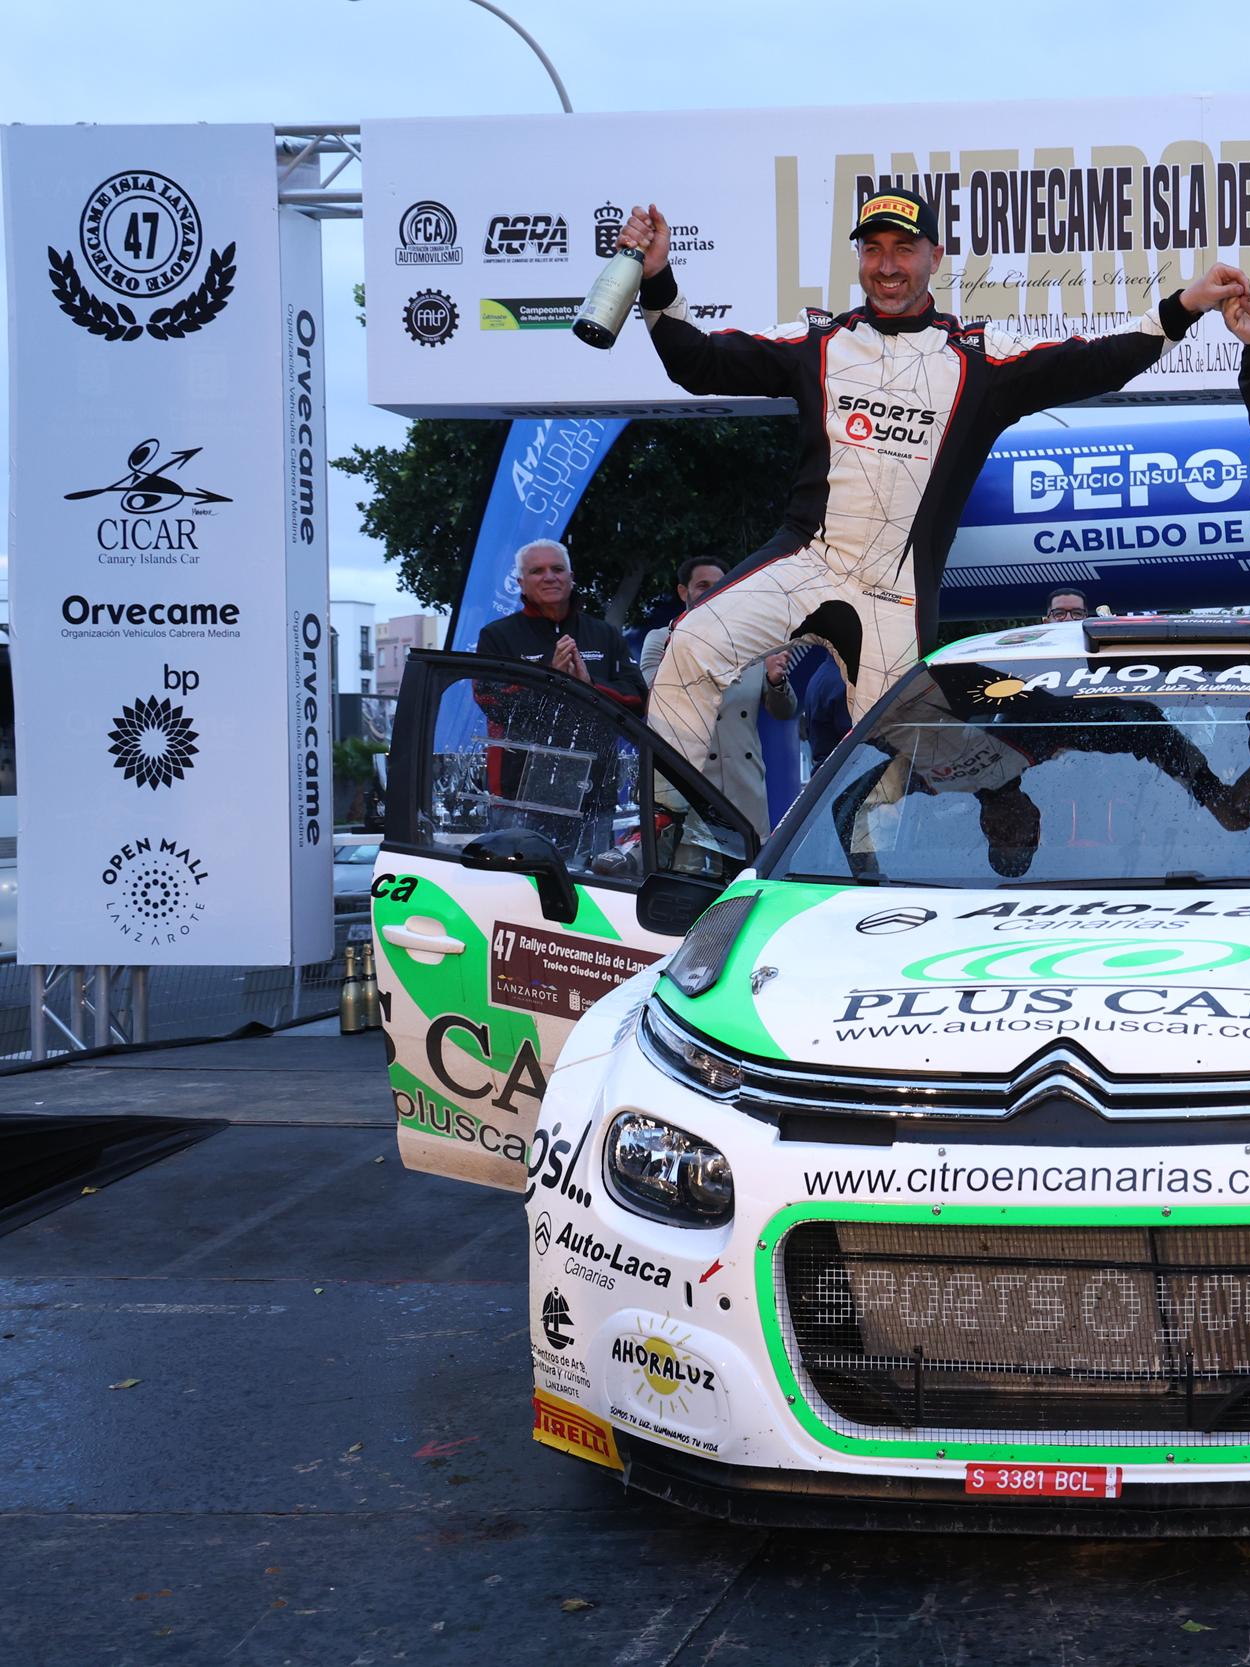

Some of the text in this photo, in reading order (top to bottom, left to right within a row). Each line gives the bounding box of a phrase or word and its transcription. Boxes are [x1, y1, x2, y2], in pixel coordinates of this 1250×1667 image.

[861, 198, 916, 219] PIRELLI
[970, 166, 1133, 256] ORVECAME
[1143, 163, 1206, 251] ISLA
[112, 176, 155, 194] ISLA
[146, 181, 197, 290] LANZAROTE
[124, 211, 160, 260] 47
[414, 216, 443, 242] FCA
[398, 249, 460, 264] AUTOMOVILISMO
[1003, 269, 1063, 290] Ciudad
[1068, 268, 1087, 286] de
[1092, 261, 1172, 298] Arrecife
[520, 305, 573, 316] Campeonato
[837, 395, 937, 425] SPORTS
[297, 309, 316, 546] Orvecame
[877, 448, 913, 460] CANARIAS
[1031, 463, 1248, 492] SERVICIO INSULAR DE
[97, 518, 200, 550] CICAR
[1033, 523, 1188, 555] CABILDO
[1198, 520, 1244, 545] DE
[98, 552, 200, 567] Canary Islands Car
[61, 595, 241, 626] Orvecame
[61, 628, 241, 640] Organización Vehículos Cabrera Medina
[164, 663, 200, 696] bp
[1076, 685, 1127, 696] SOMOS
[1131, 684, 1151, 693] TU
[302, 613, 321, 847] Orvecame
[102, 837, 209, 885] OPEN MALL
[106, 902, 206, 946] LANZAROTE
[992, 916, 1193, 932] Canarias
[493, 929, 516, 962] 47
[519, 935, 547, 956] Rallye
[548, 941, 594, 964] Orvecame
[595, 951, 611, 967] Isla
[612, 955, 625, 970] de
[542, 958, 569, 973] Trofeo
[570, 964, 600, 979] Ciudad
[601, 970, 613, 983] de
[496, 981, 558, 1003] LANZAROTE
[833, 988, 1095, 1023] PLUS
[555, 1221, 672, 1288] Auto-Laca
[564, 1256, 617, 1292] Canarias
[560, 1355, 570, 1367] de
[611, 1337, 716, 1392] AHORALUZ
[545, 1379, 580, 1399] LANZAROTE
[533, 1399, 611, 1458] PIRELLI
[610, 1406, 629, 1420] SOMOS
[702, 1442, 718, 1452] VIDA
[971, 1468, 1095, 1492] S 3381 BCL
